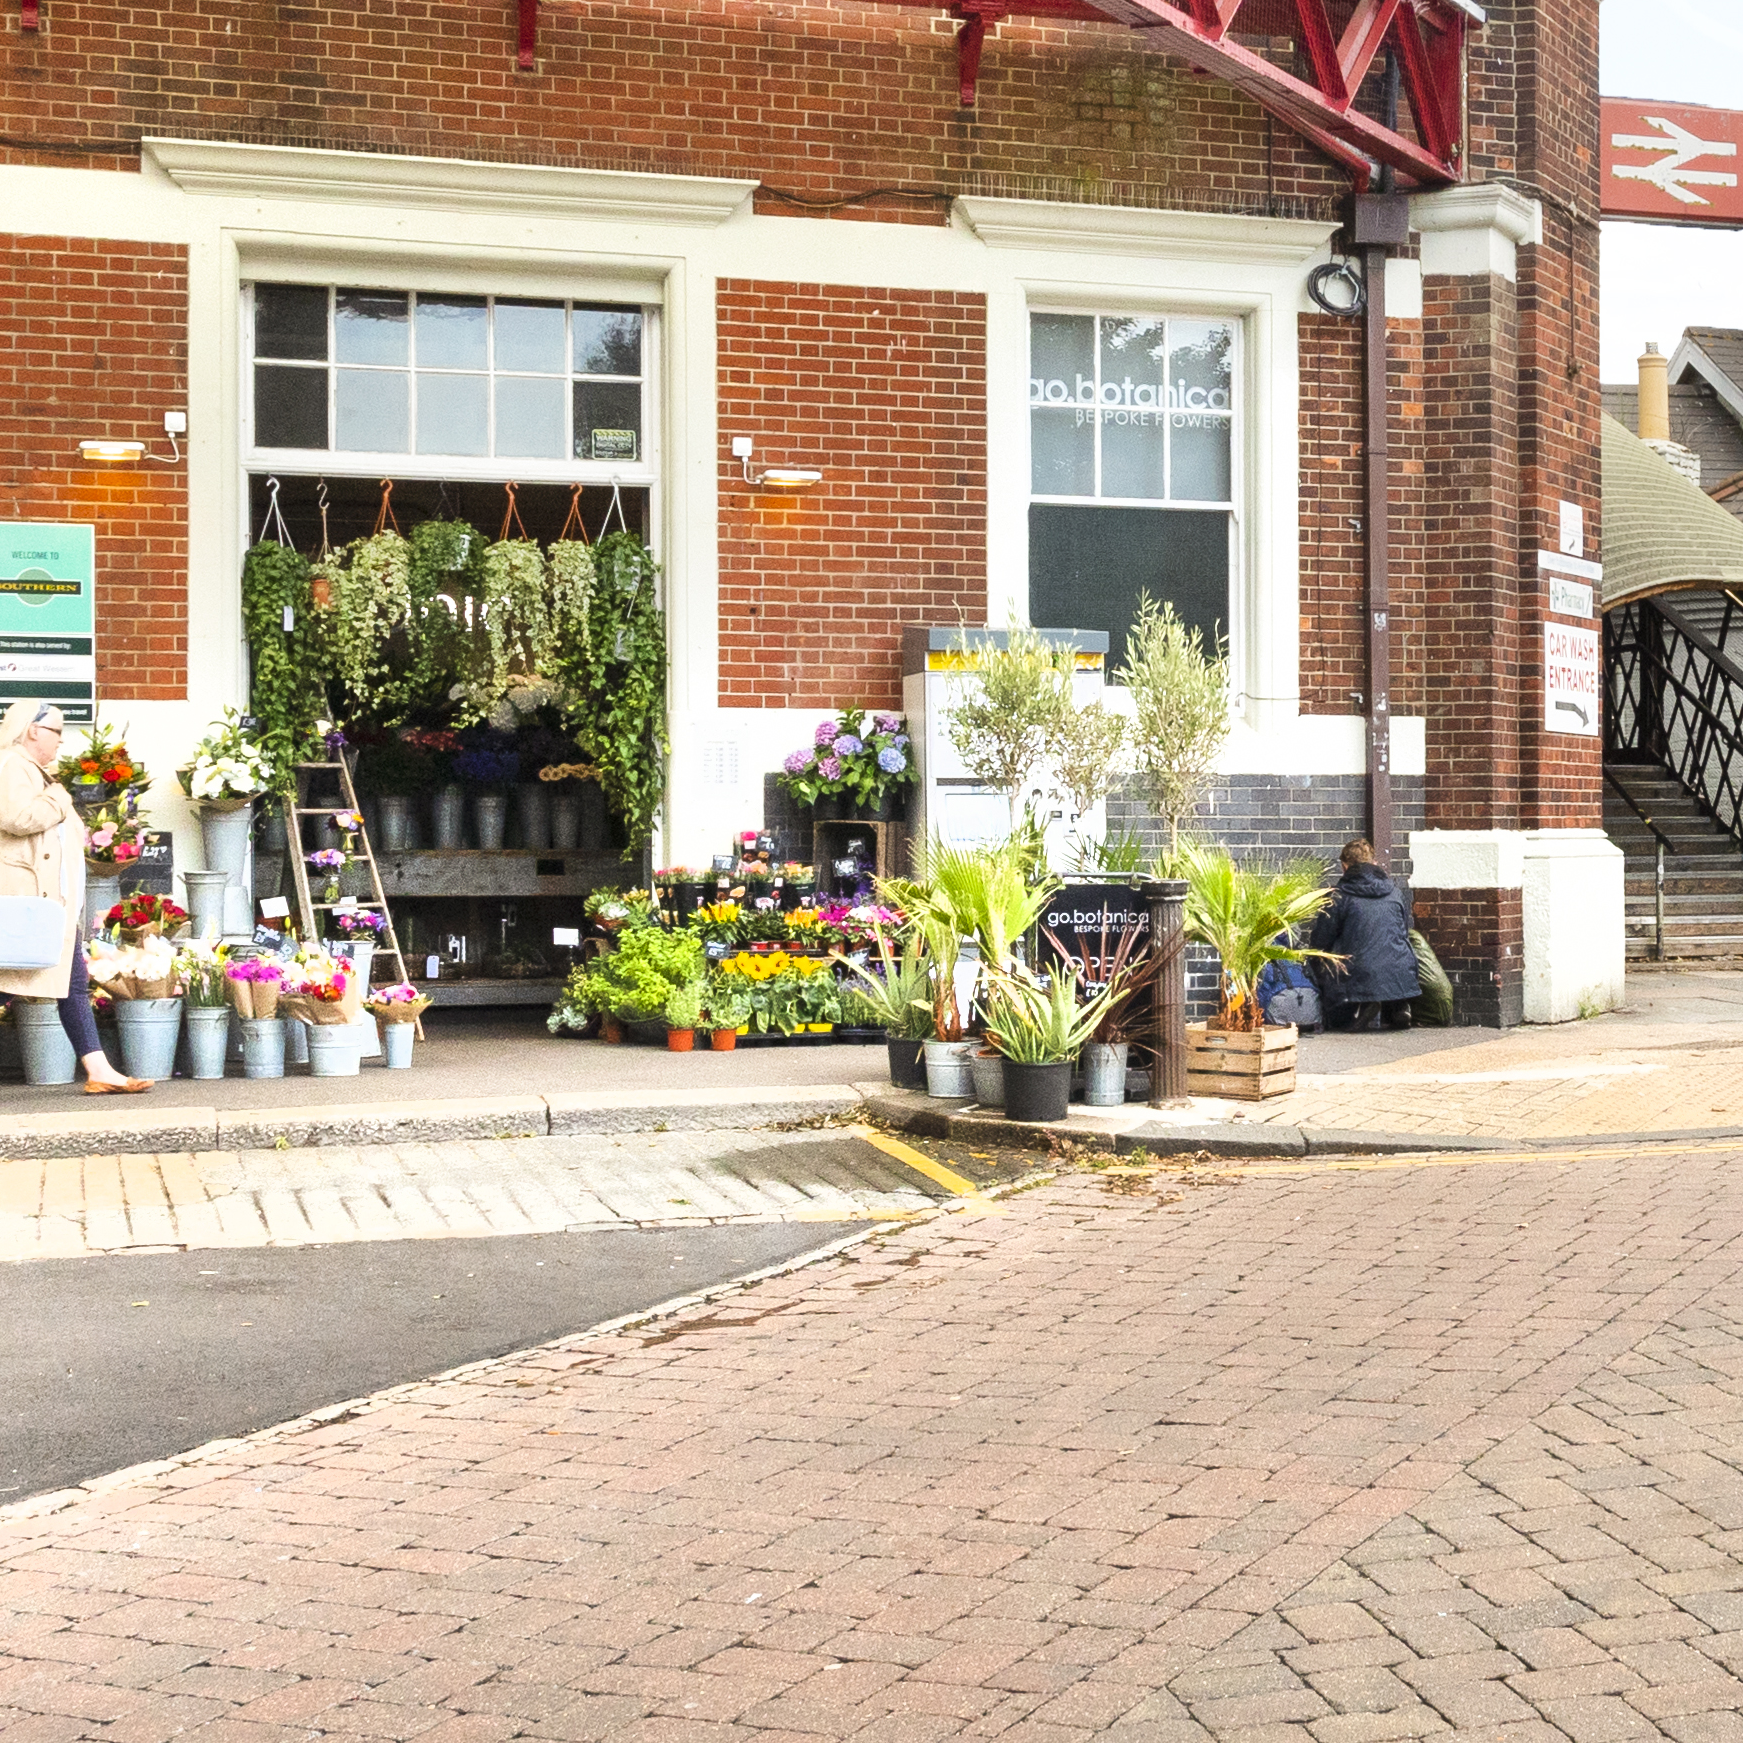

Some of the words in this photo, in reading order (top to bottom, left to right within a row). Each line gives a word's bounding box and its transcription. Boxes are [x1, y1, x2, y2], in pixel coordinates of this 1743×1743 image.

[1155, 412, 1230, 430] FOWERS
[12, 551, 48, 560] WELCOME
[50, 551, 60, 560] TO
[1549, 632, 1567, 658] CAR
[1569, 635, 1595, 663] WASH
[1549, 665, 1596, 694] ENTRANCE
[1048, 909, 1150, 927] go.botanica
